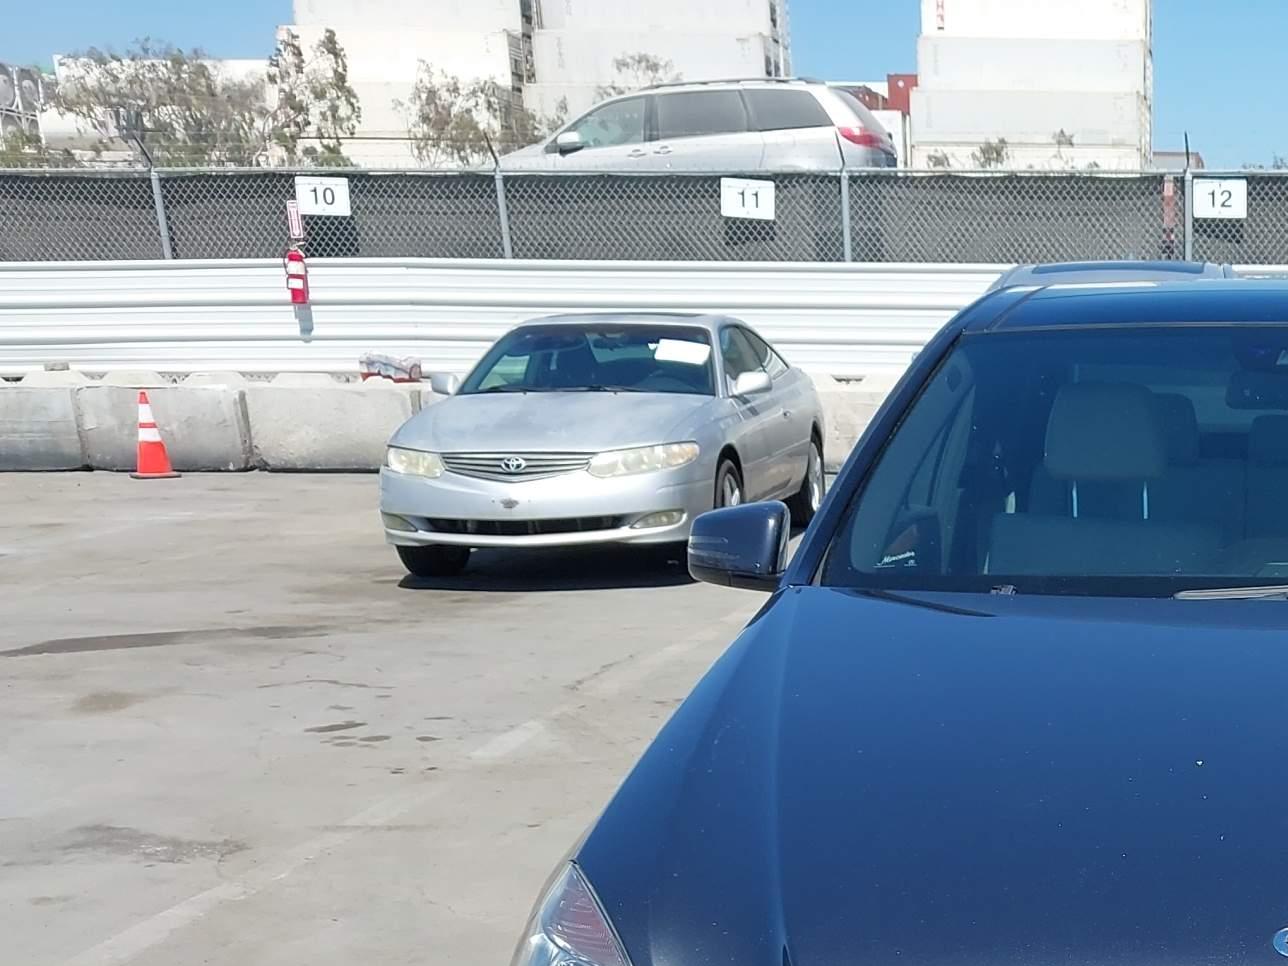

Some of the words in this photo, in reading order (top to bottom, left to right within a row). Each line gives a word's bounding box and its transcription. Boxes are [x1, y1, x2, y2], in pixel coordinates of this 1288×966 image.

[309, 186, 336, 206] 10
[737, 190, 760, 209] 11
[1207, 189, 1233, 208] 12
